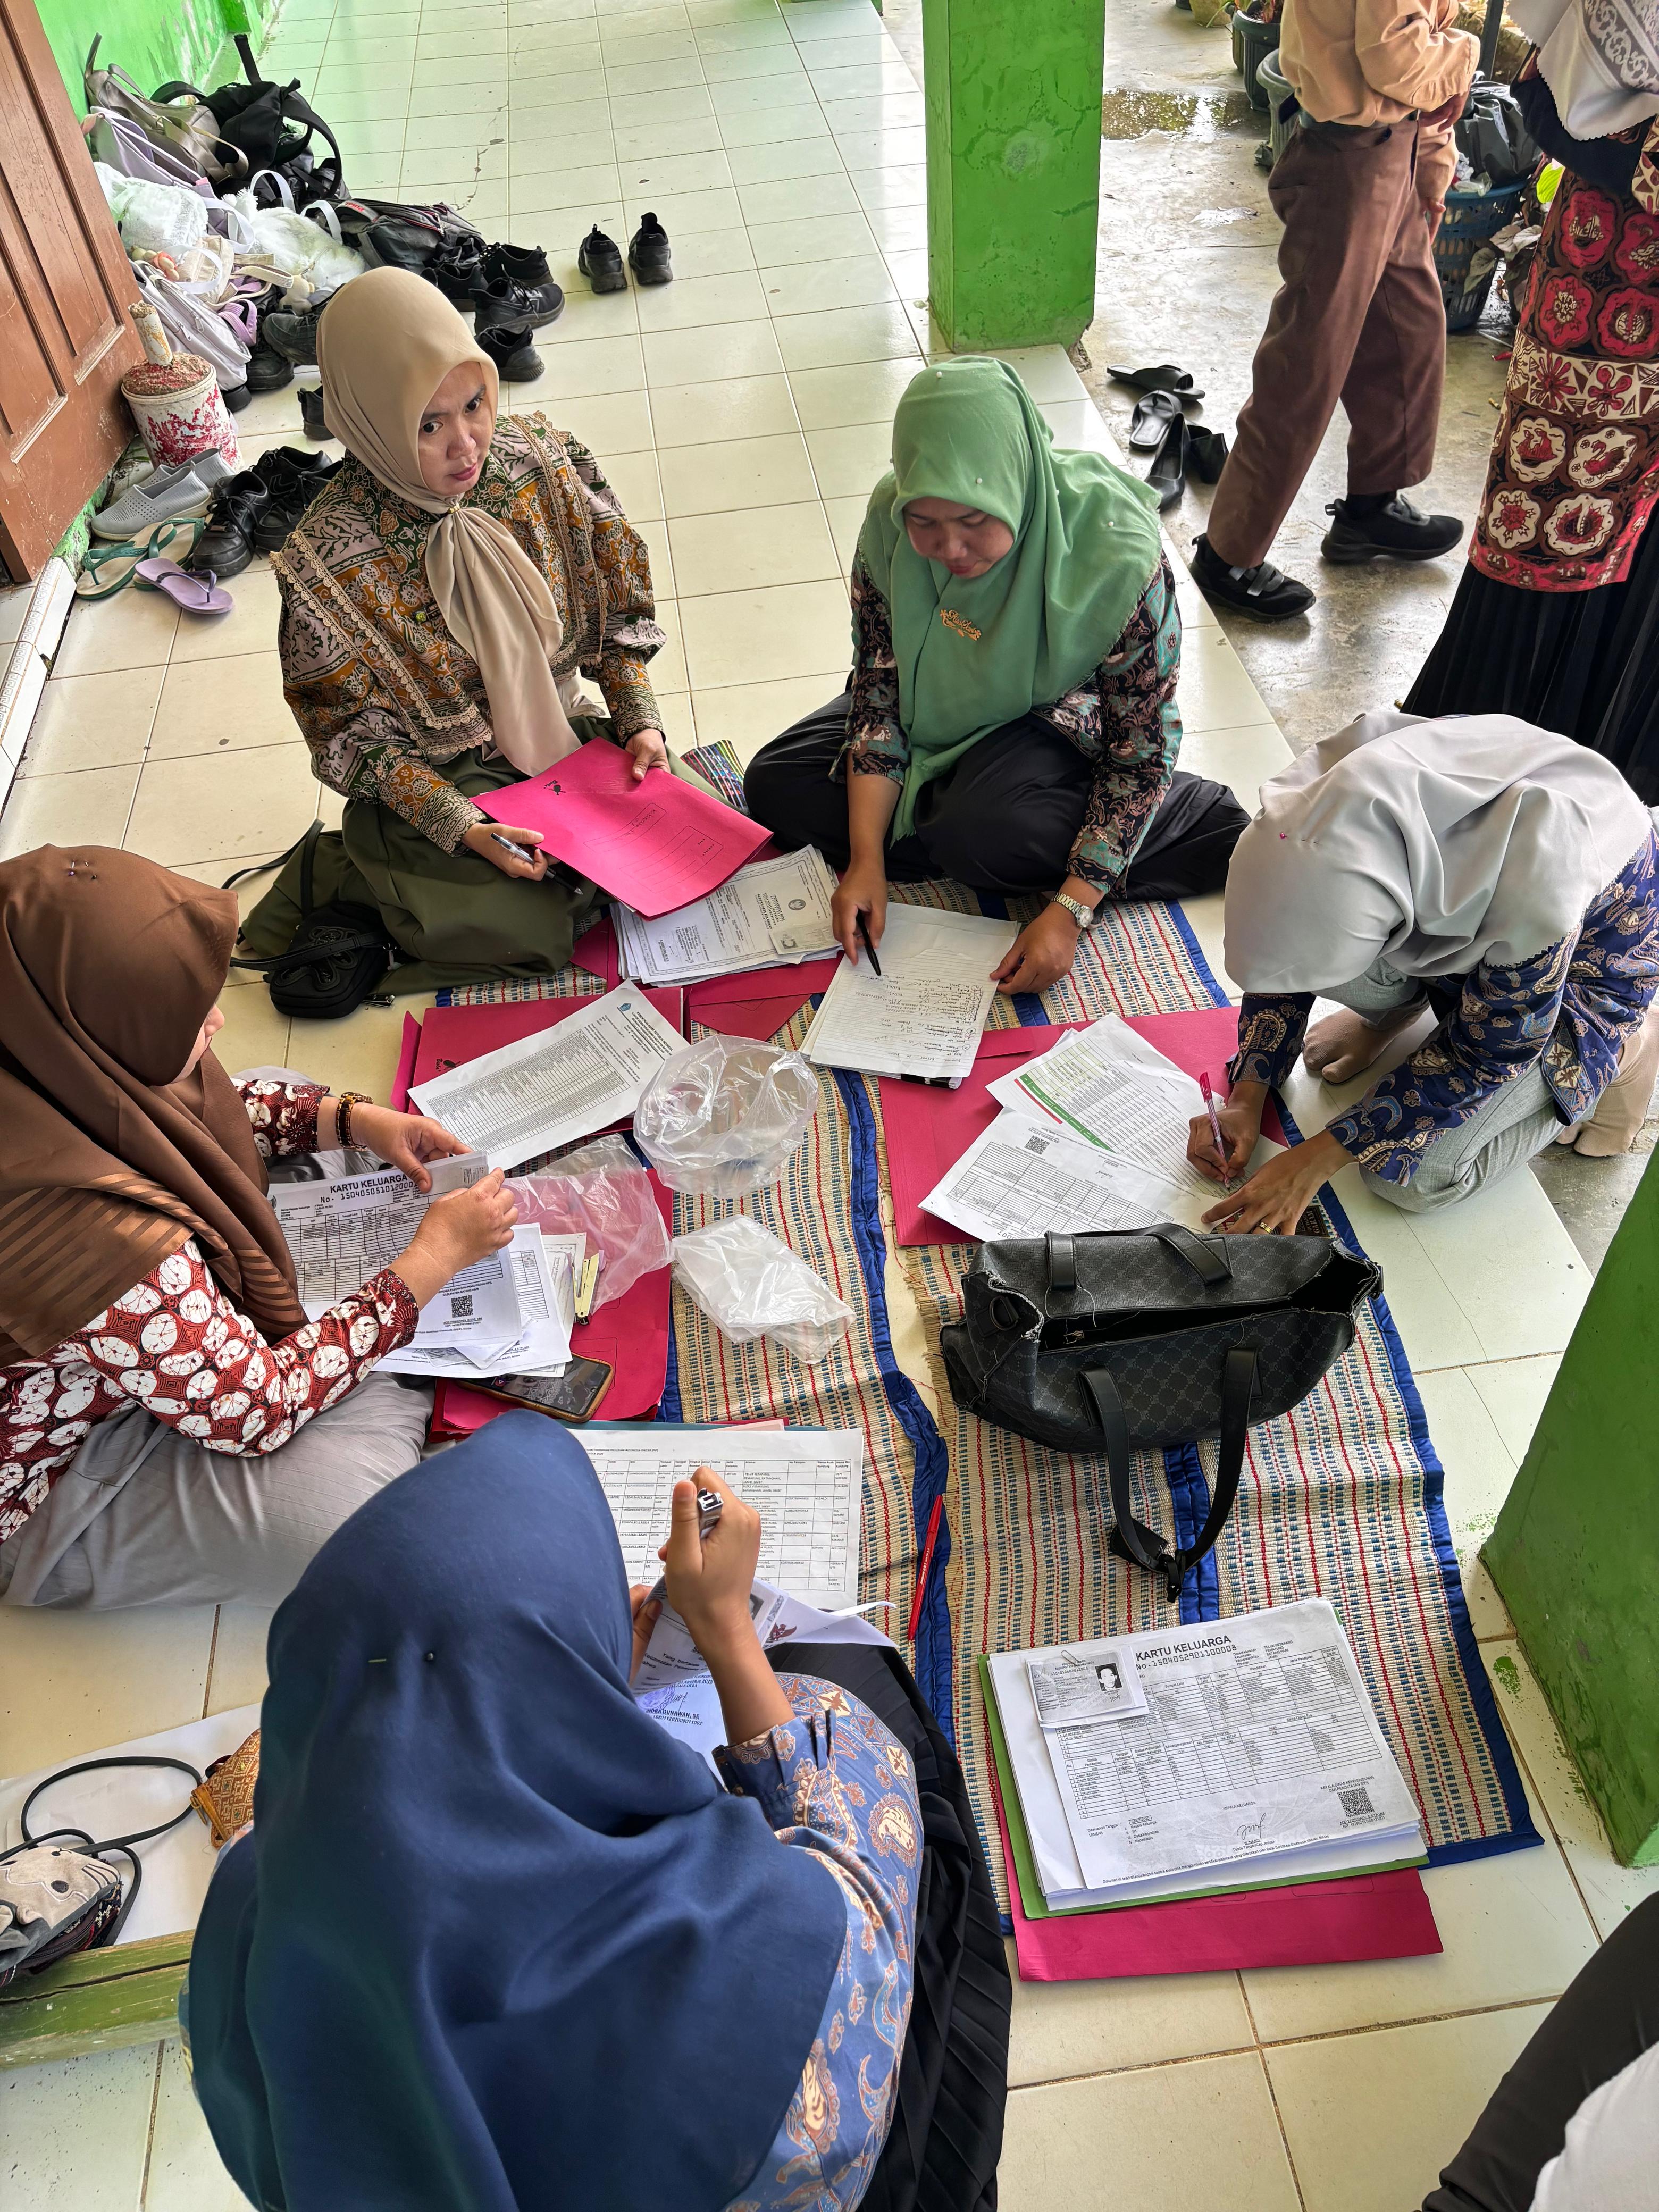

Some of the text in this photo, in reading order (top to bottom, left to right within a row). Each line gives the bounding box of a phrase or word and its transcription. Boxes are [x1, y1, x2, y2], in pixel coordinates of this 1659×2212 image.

[330, 1174, 408, 1193] KARTU KELUARGA
[1306, 1211, 1320, 1233] GARAM
[1135, 1634, 1232, 1661] KARTU KELUARGA
